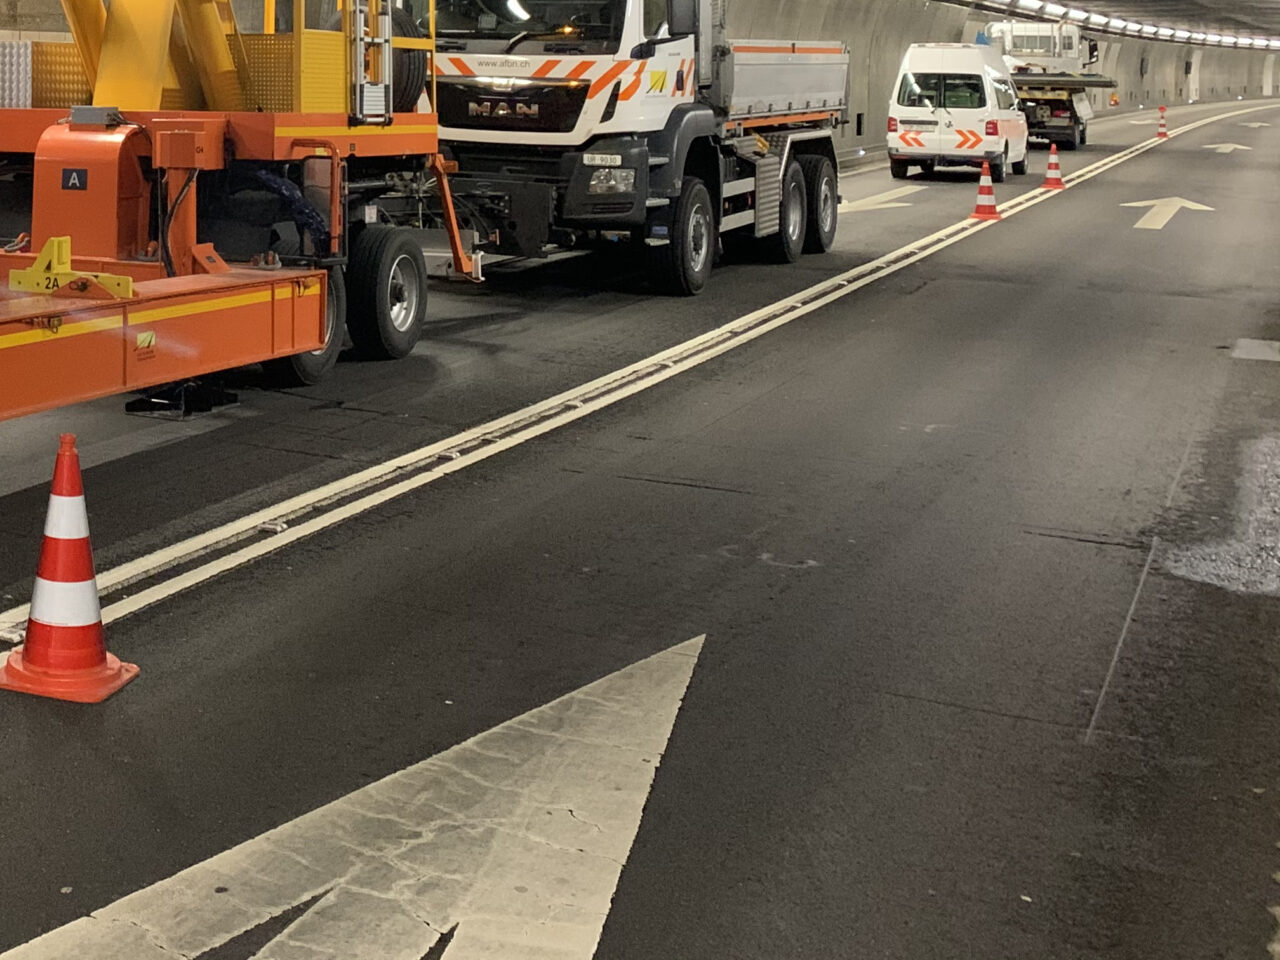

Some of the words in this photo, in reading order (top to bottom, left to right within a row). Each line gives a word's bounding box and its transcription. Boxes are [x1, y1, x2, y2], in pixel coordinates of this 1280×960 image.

[468, 101, 539, 118] MAN
[67, 172, 81, 188] A
[45, 276, 60, 291] 2A
